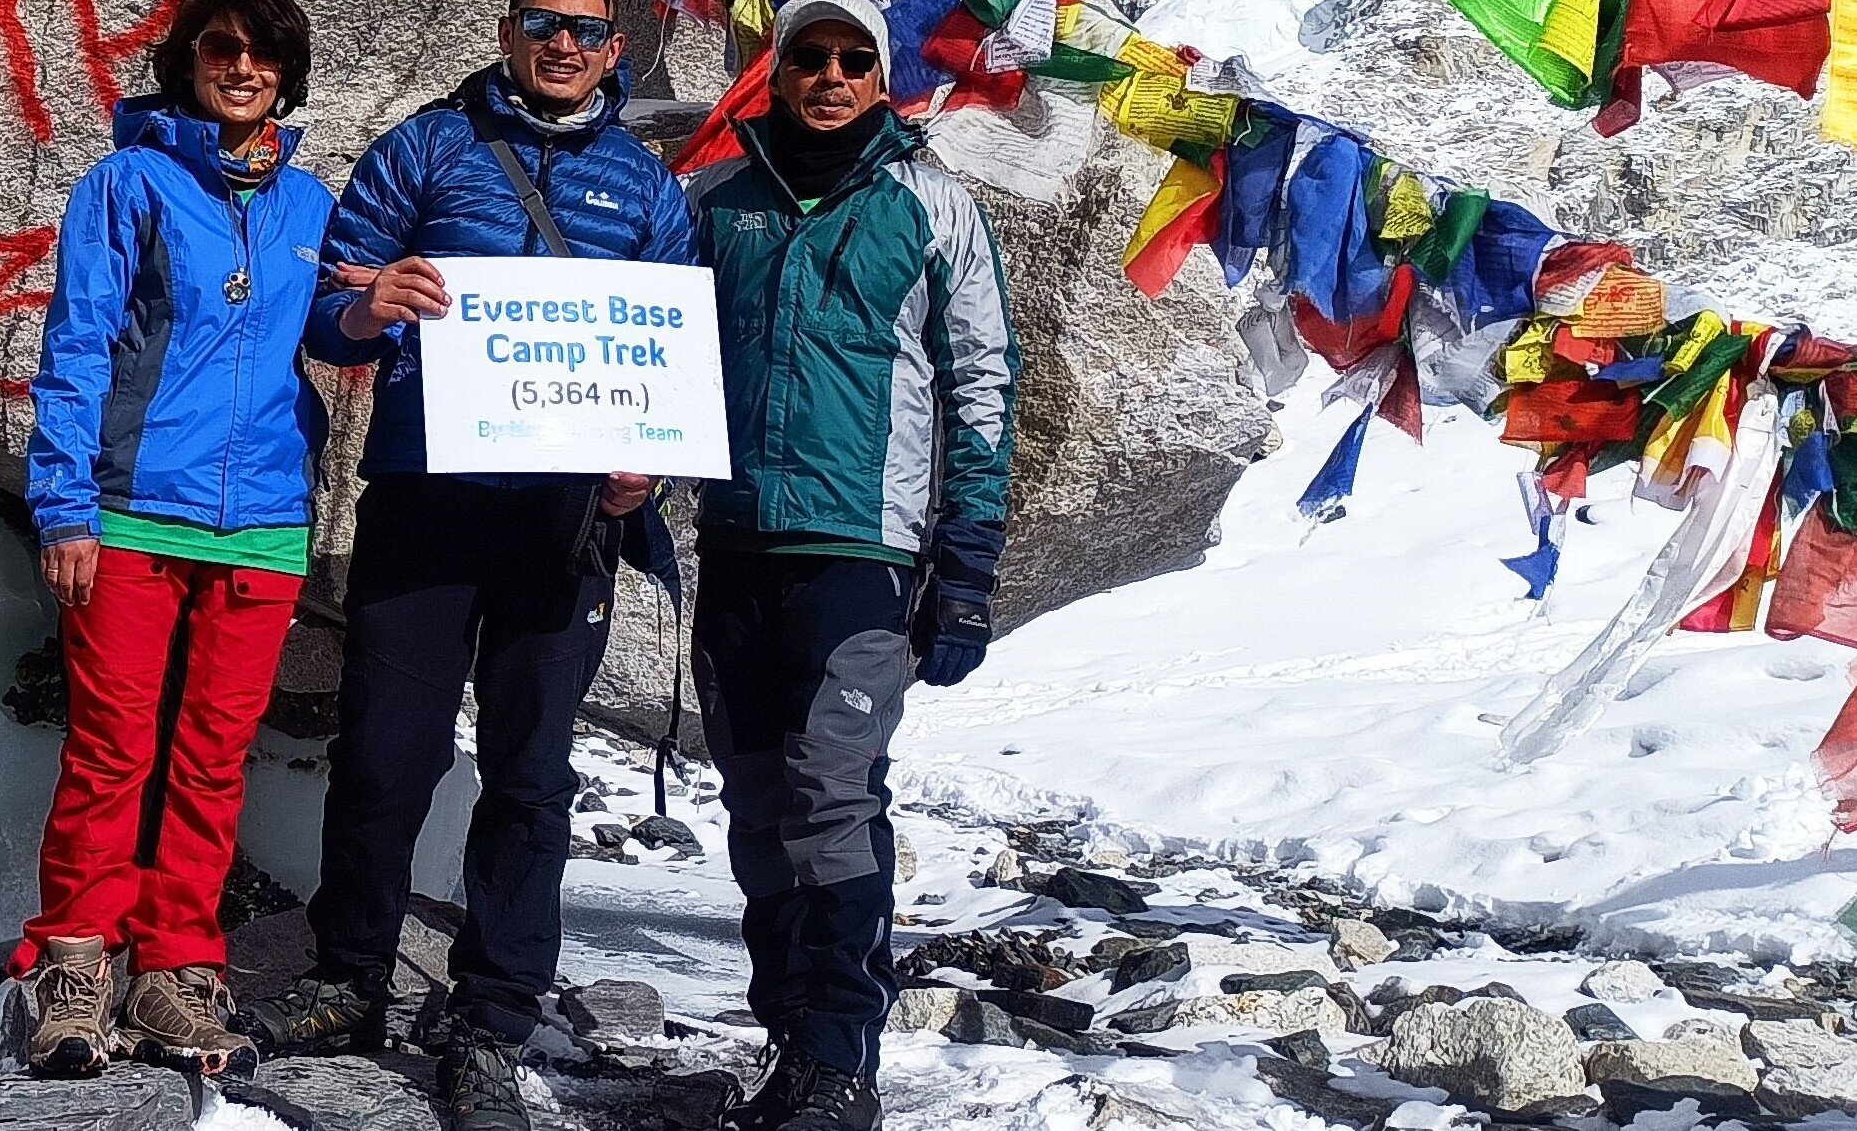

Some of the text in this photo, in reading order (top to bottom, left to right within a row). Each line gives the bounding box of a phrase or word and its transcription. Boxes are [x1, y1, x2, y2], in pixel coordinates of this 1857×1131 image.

[460, 293, 684, 329] Everest Base
[486, 333, 668, 372] Camp Trek
[511, 379, 650, 414] (5,364 m.)
[635, 422, 683, 442] Team
